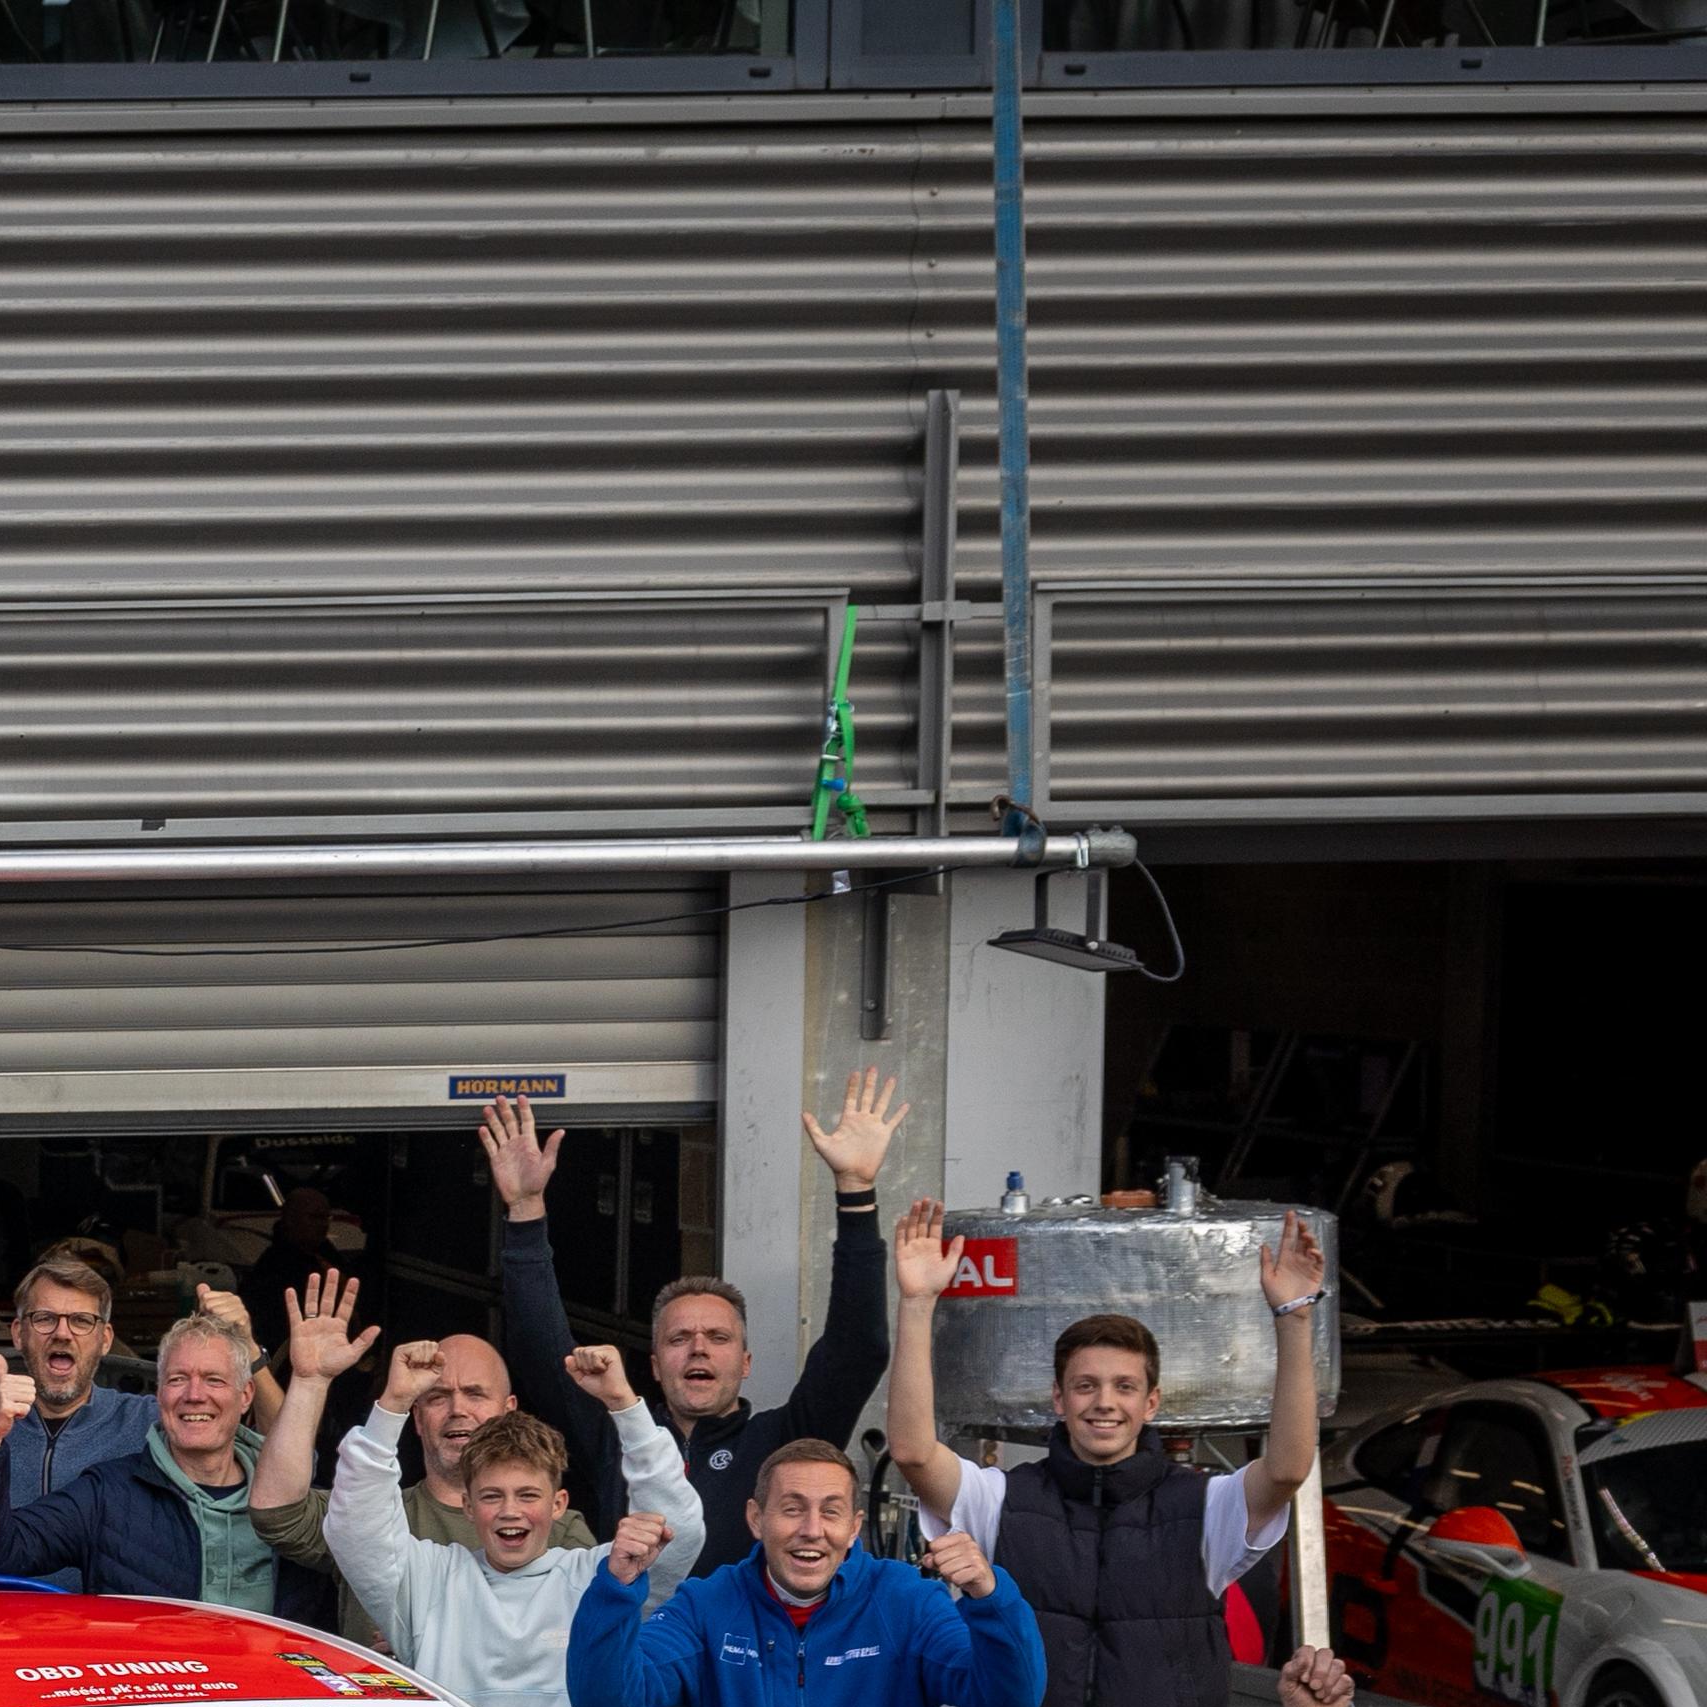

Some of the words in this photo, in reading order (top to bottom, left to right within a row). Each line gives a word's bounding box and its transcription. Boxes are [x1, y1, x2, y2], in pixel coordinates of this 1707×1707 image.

[456, 1077, 557, 1095] HÖRMANN
[15, 1664, 84, 1683] OBD
[86, 1660, 210, 1679] TUNING
[111, 1681, 144, 1696] pk's
[147, 1682, 169, 1692] uit
[173, 1683, 197, 1692] uw
[201, 1681, 239, 1692] auto
